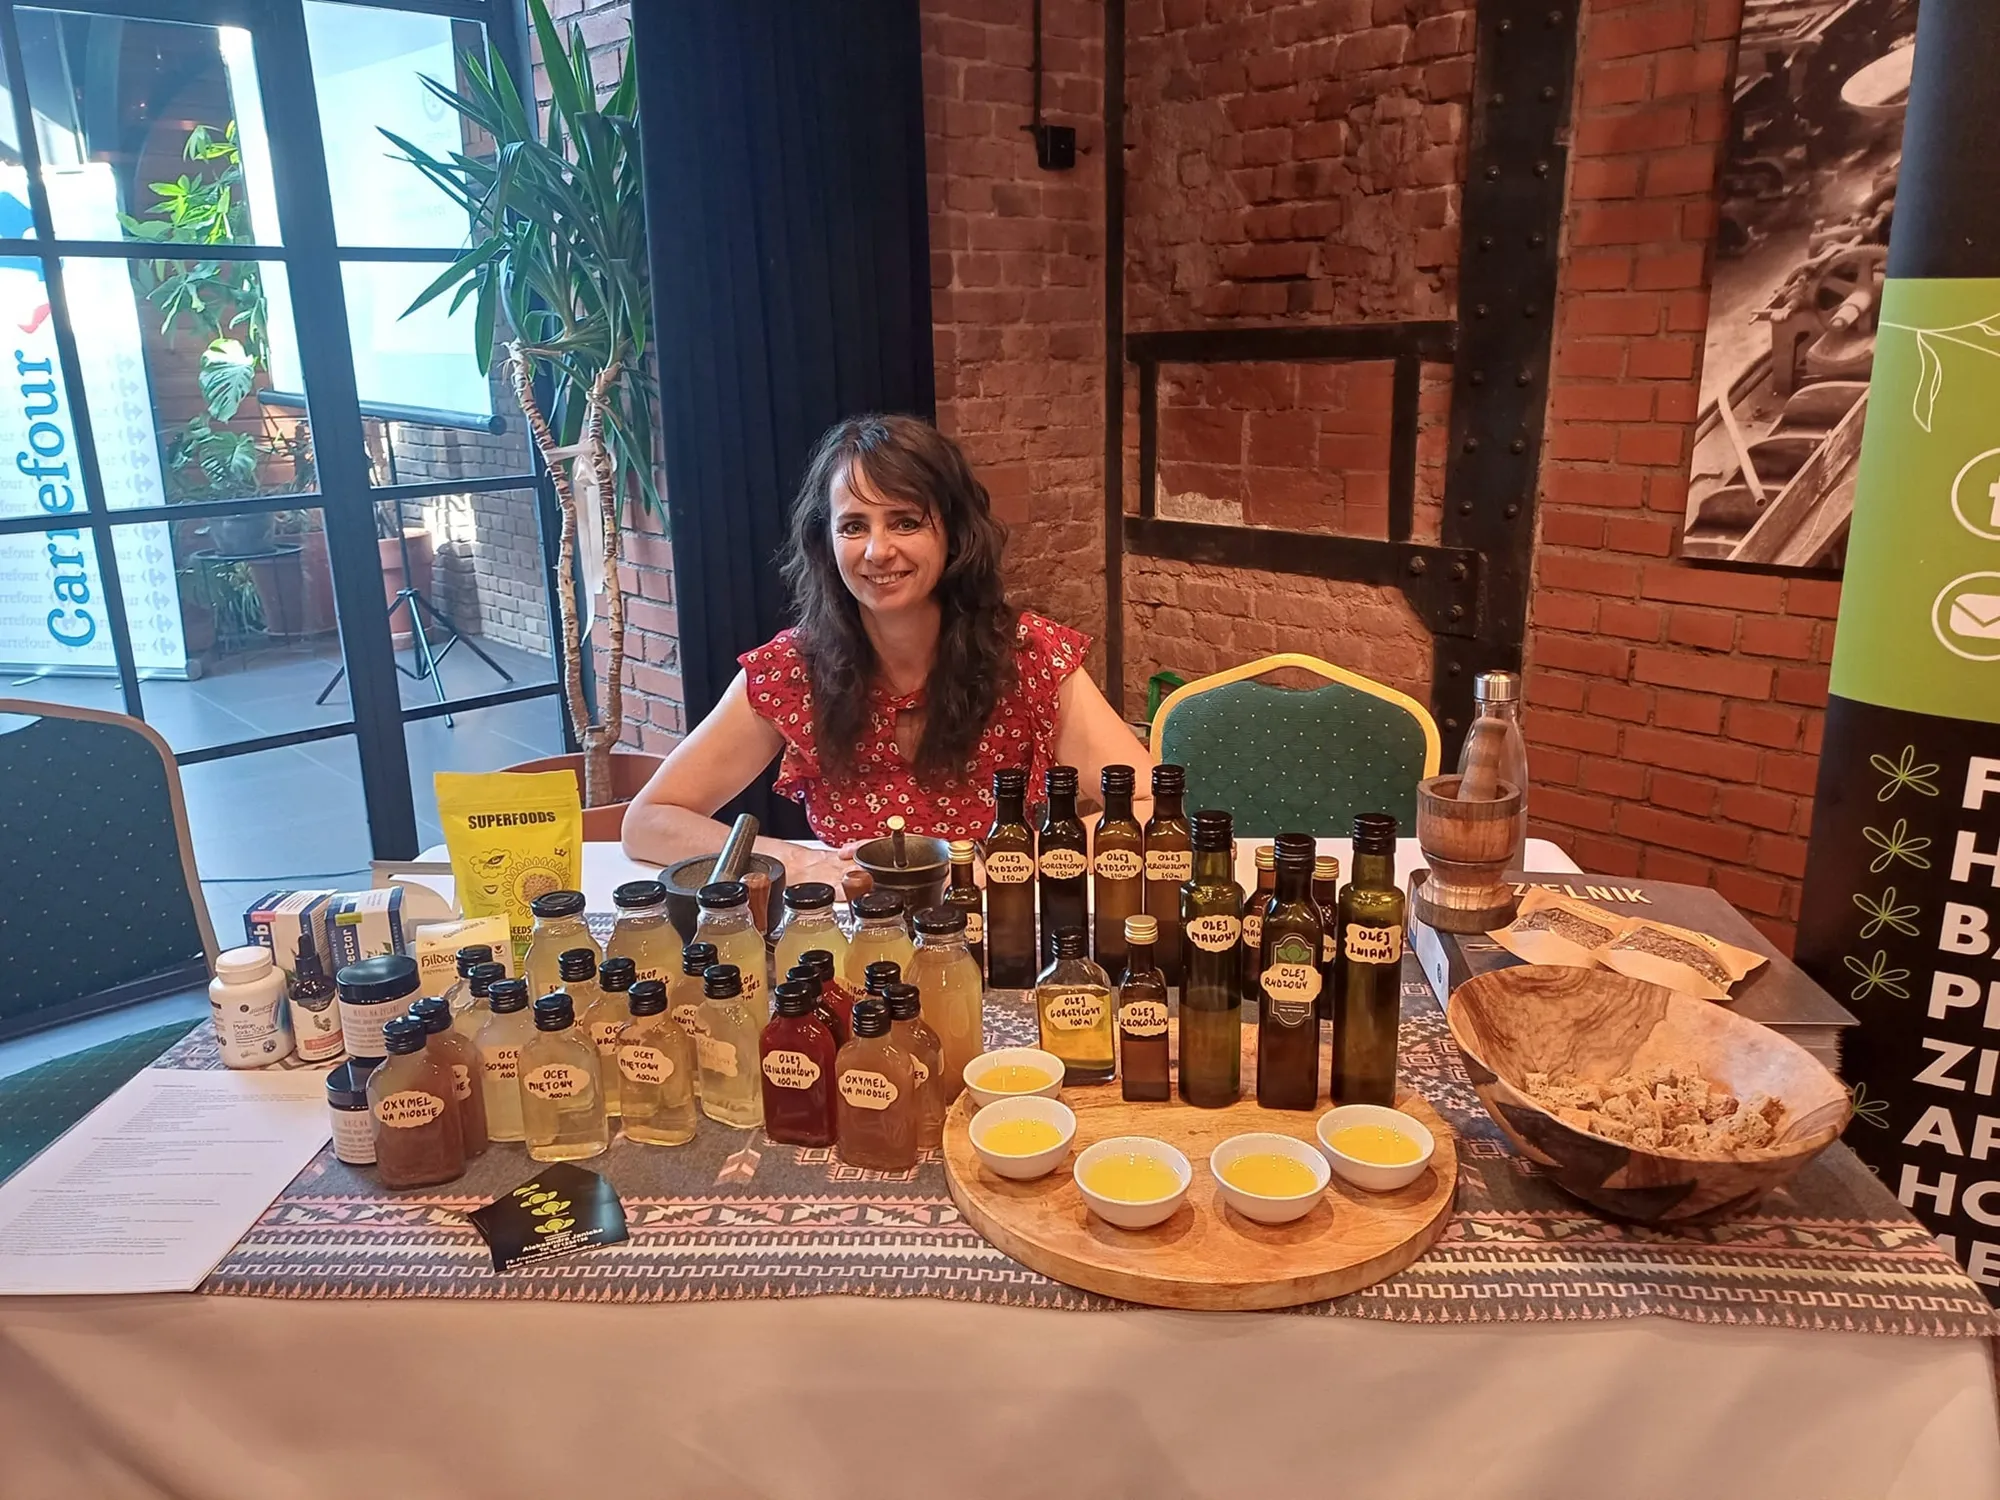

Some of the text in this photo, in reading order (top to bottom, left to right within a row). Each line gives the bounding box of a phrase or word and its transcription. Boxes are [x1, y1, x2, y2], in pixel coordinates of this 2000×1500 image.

[468, 811, 556, 829] SUPERFOODS
[998, 855, 1020, 863] OLEJ
[1052, 854, 1073, 863] OLEJ
[1107, 853, 1129, 863] OLEJ
[1157, 853, 1181, 862] OLEJ
[510, 926, 532, 935] EEDS
[1202, 920, 1228, 931] OLEJ
[1938, 902, 2000, 960] B
[1192, 931, 1236, 944] MAKOWY
[1359, 931, 1390, 945] OLEJ
[1350, 944, 1394, 959] LNIANY
[1281, 968, 1307, 979] OLEJ
[1264, 977, 1308, 989] RYDZOWY
[1064, 998, 1086, 1007] OLEJ
[1131, 1006, 1155, 1017] OLEJ
[633, 1051, 654, 1060] OCET
[779, 1053, 801, 1066] OLEJ
[543, 1069, 569, 1079] OCET
[845, 1075, 887, 1089] OXYMEL
[855, 1087, 892, 1101] MIODZIE
[383, 1096, 432, 1112] OXYMEL
[382, 1107, 439, 1122] NA MIODZIE
